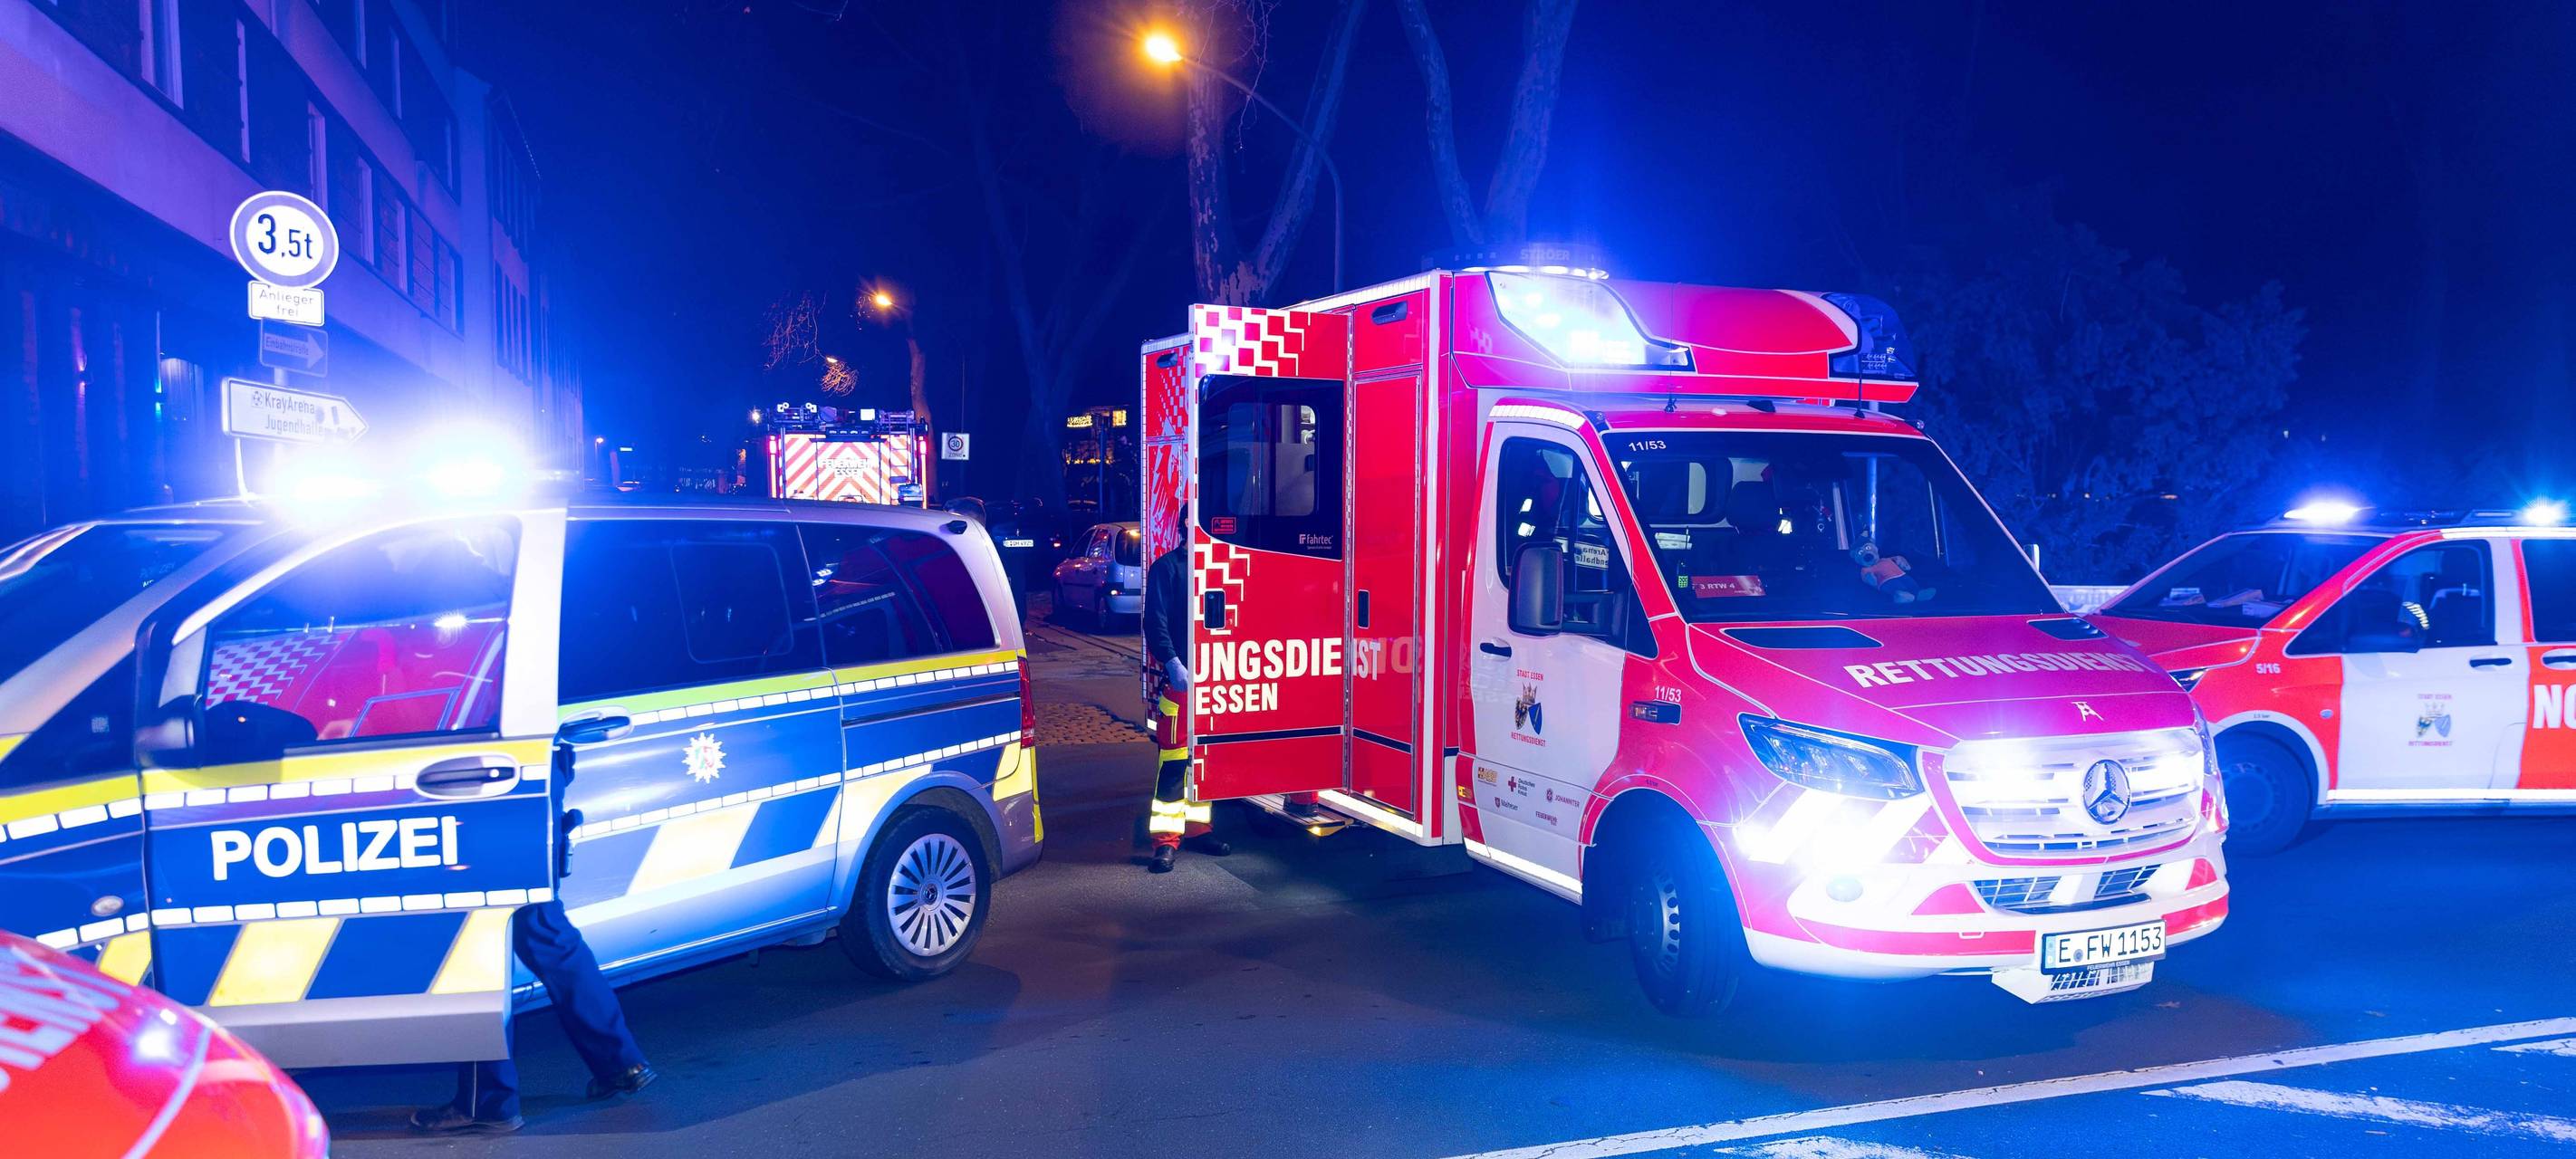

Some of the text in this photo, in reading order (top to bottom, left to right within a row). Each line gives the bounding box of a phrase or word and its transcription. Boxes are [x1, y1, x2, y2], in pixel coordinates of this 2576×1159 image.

[259, 289, 314, 306] Anlieger
[276, 304, 299, 316] frei
[264, 390, 315, 414] KrayArena
[265, 414, 323, 436] Jugendhalle
[1629, 440, 1667, 452] 11/53
[1306, 534, 1332, 544] fahrtec
[1531, 672, 1543, 681] ESSEN
[2255, 663, 2281, 674] 5/16
[1195, 682, 1278, 715] ESSEN
[1655, 685, 1681, 703] 11/53
[1554, 795, 1580, 808] JOHANNITER
[211, 816, 459, 881] POLIZEI
[2059, 938, 2071, 963] E
